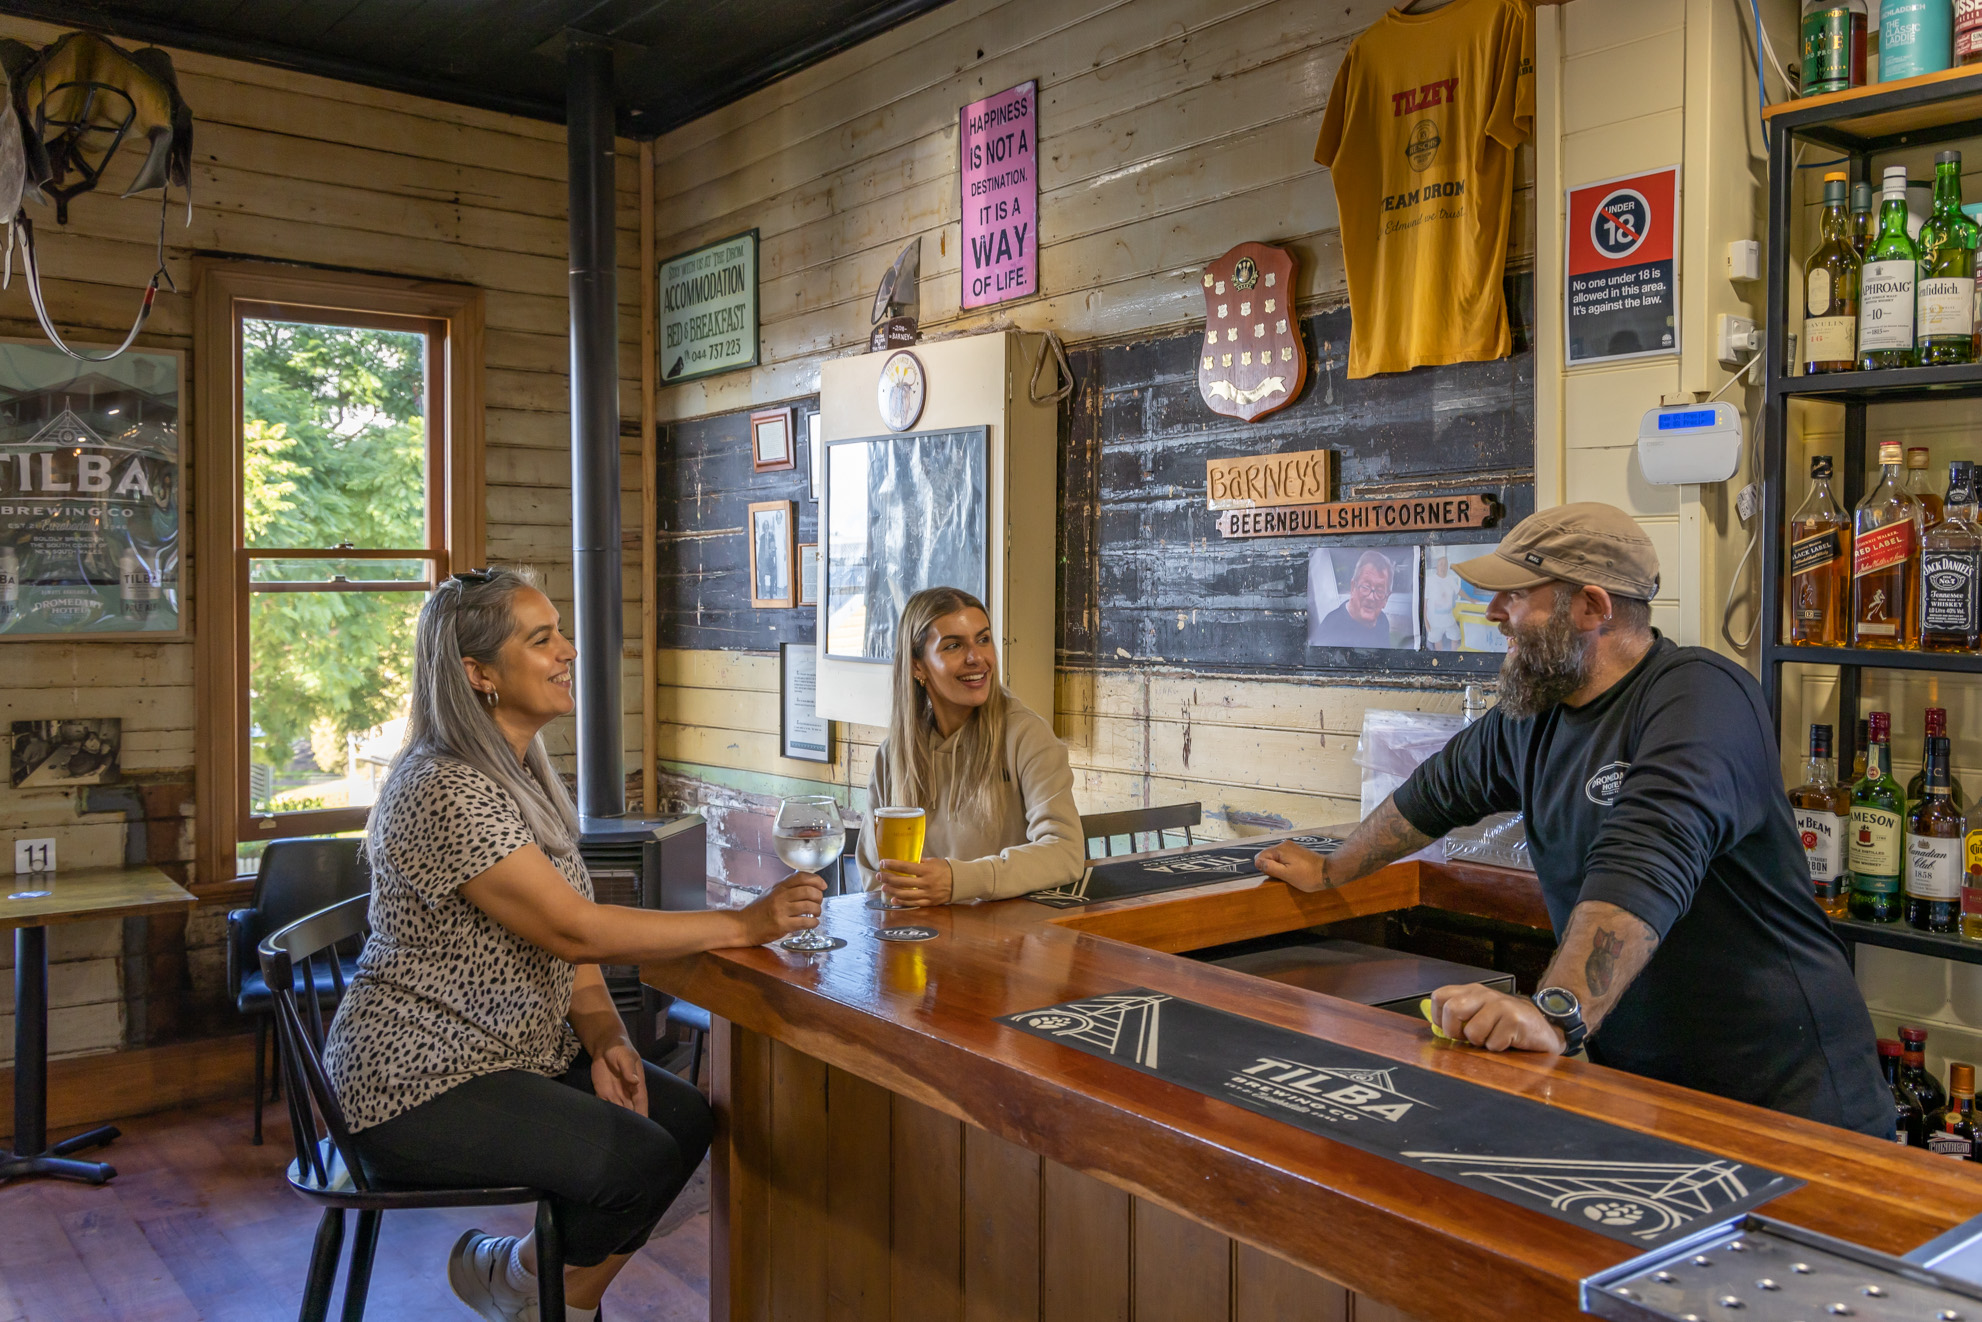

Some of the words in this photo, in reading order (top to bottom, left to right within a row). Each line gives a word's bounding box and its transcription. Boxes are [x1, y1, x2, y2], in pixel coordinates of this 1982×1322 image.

[1886, 18, 1899, 30] THE
[1886, 23, 1920, 38] CLASSIC
[1885, 31, 1916, 46] LADDIE
[1392, 78, 1459, 117] TILZEY
[969, 97, 1028, 136] HAPPINESS
[970, 145, 982, 171] IS
[986, 133, 1015, 165] NOT
[1018, 129, 1028, 153] A
[971, 167, 1028, 197] DESTINATION.
[1423, 179, 1465, 201] DROM
[980, 206, 991, 226] IT
[996, 201, 1007, 221] IS
[1011, 197, 1021, 217] A
[1605, 201, 1634, 214] UNDER
[1384, 213, 1423, 235] Edmund
[1425, 213, 1436, 222] we
[1439, 206, 1466, 219] trust
[1604, 214, 1636, 246] 18
[971, 222, 1028, 270] WAY
[664, 263, 745, 314] ACCOMMODATION
[972, 276, 992, 297] OF
[996, 267, 1027, 292] LIFE.
[1573, 280, 1586, 291] No
[1588, 278, 1606, 289] one
[1608, 273, 1636, 285] under
[1638, 270, 1650, 280] 18
[1652, 268, 1661, 278] is
[1573, 289, 1609, 303] allowed
[1611, 287, 1620, 298] in
[1621, 285, 1639, 296] this
[1641, 282, 1666, 293] area.
[1573, 304, 1586, 316] It's
[1588, 301, 1623, 316] against
[1624, 297, 1641, 309] the
[1642, 294, 1662, 306] law.
[1872, 308, 1883, 320] 10
[667, 322, 683, 349] BED
[684, 322, 689, 340] &
[689, 303, 746, 342] BREAKFAST
[691, 349, 707, 362] 044
[709, 342, 724, 360] 737
[726, 338, 741, 357] 223
[1, 506, 102, 517] BREWING
[108, 508, 133, 518] CO
[1230, 500, 1470, 535] BEERNBULLSHITCORNER
[1811, 542, 1831, 554] LABEL
[1855, 547, 1871, 557] RED
[1873, 537, 1901, 550] LABEL
[1924, 561, 1942, 576] JACK
[1942, 558, 1974, 577] DANIEL'S
[1931, 591, 1964, 599] Tennessee
[1806, 816, 1831, 838] BEAM
[24, 844, 48, 867] 11
[1908, 844, 1947, 859] Canadian
[1143, 856, 1251, 873] TILBA
[1915, 870, 1932, 879] 1858
[1231, 1077, 1326, 1110] BREWING
[1329, 1108, 1359, 1121] CO
[1242, 1058, 1414, 1122] TILBA
